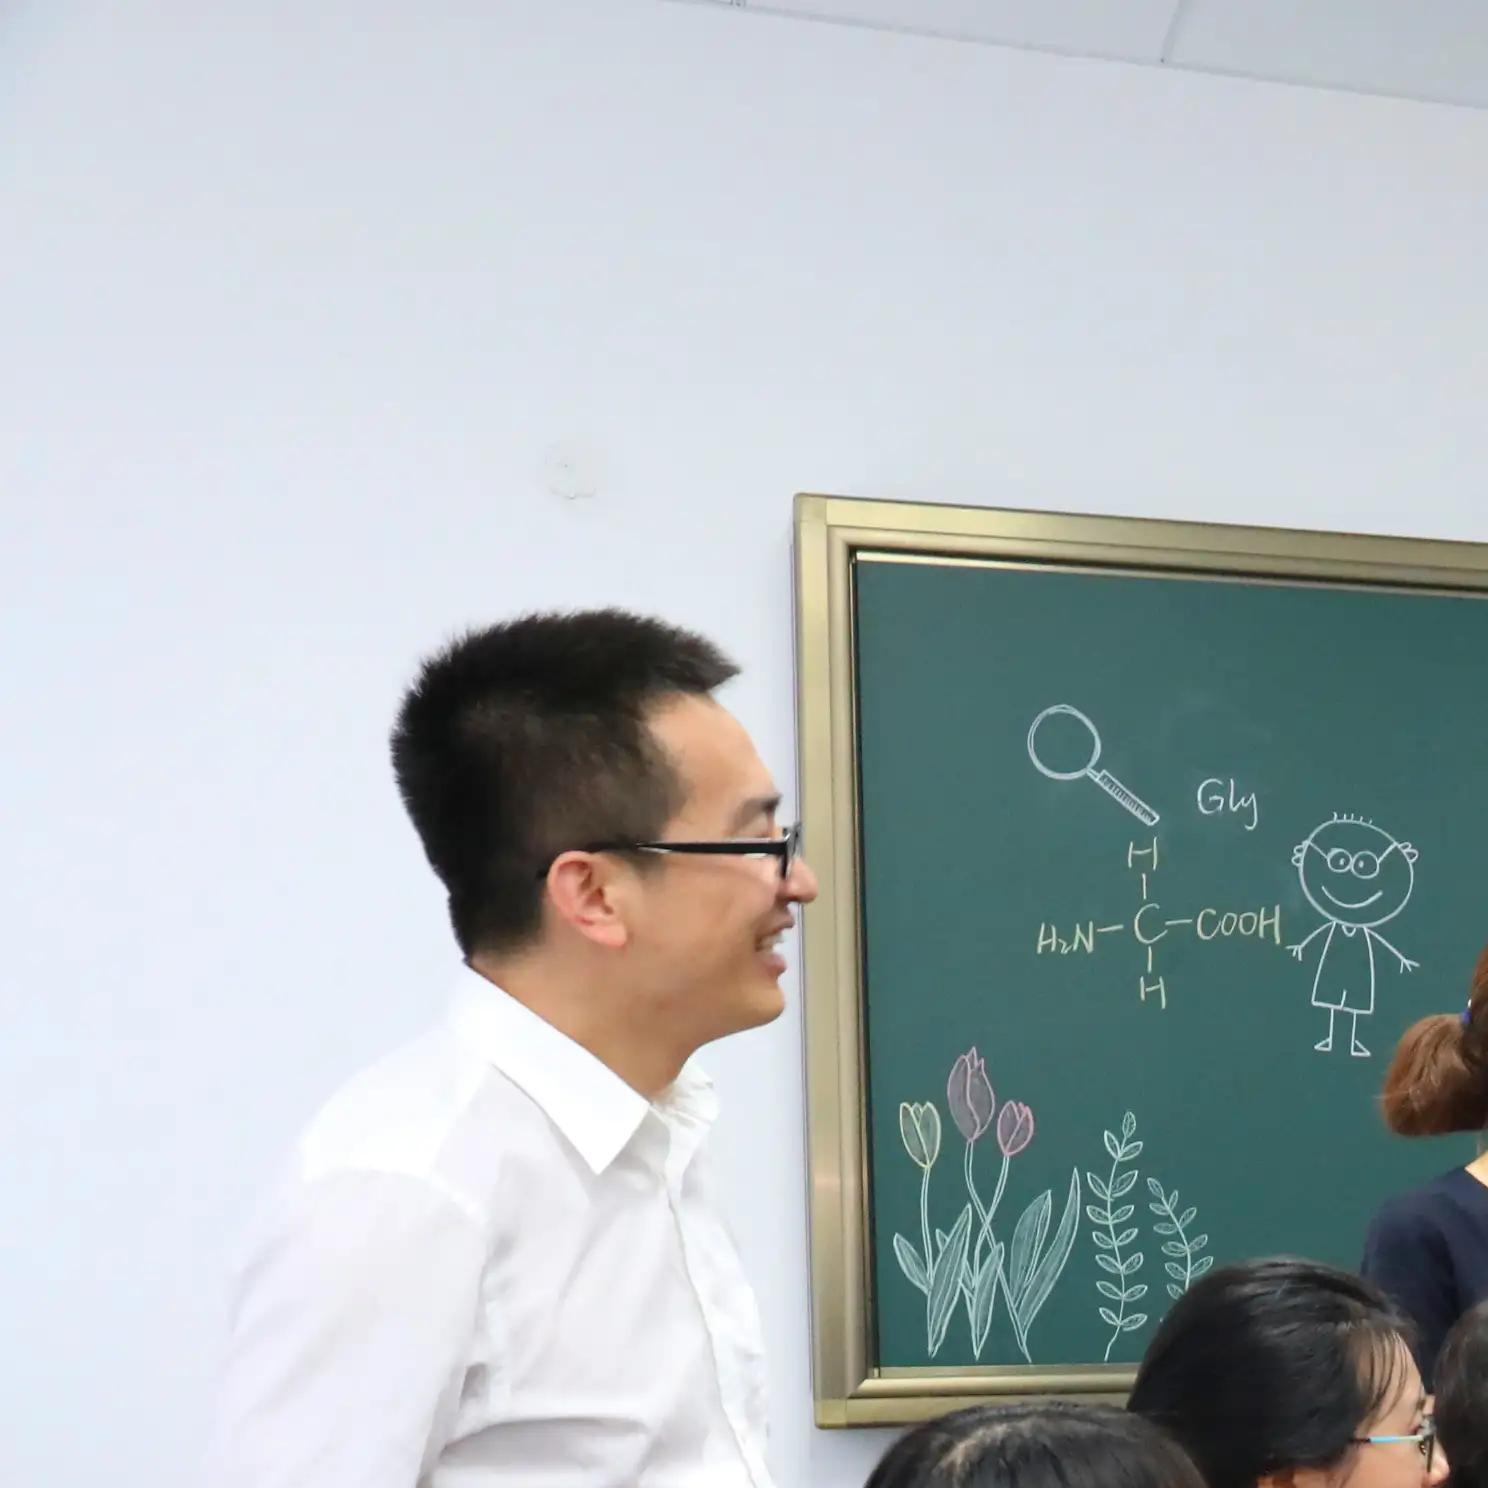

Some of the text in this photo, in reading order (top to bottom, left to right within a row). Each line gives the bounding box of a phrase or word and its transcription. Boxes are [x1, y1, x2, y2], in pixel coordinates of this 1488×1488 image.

[1197, 778, 1258, 830] Gly
[1128, 837, 1158, 870] H
[1140, 976, 1166, 1009] H
